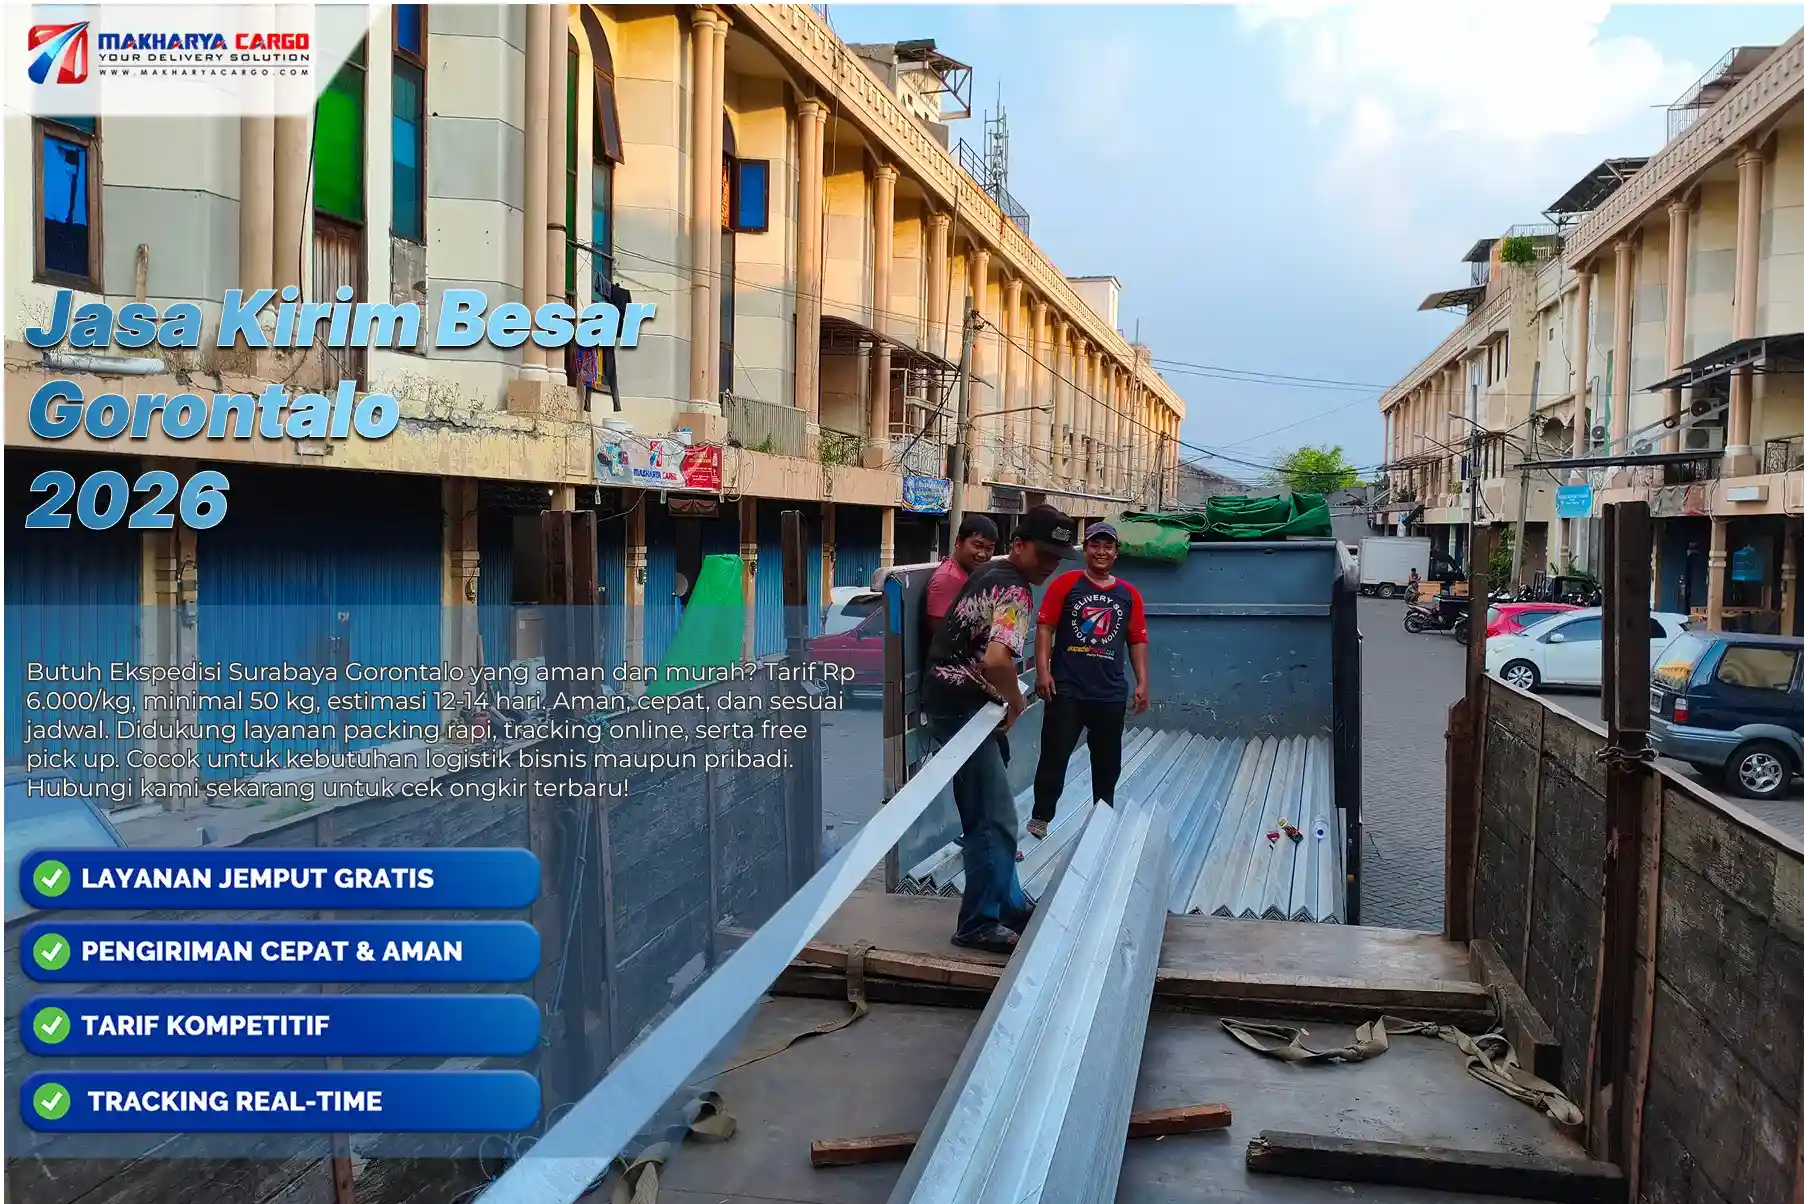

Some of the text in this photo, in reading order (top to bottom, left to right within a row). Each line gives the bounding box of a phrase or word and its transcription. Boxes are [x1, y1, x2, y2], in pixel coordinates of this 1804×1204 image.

[1071, 594, 1124, 645] YOUR DELIVERY SOLUTION
